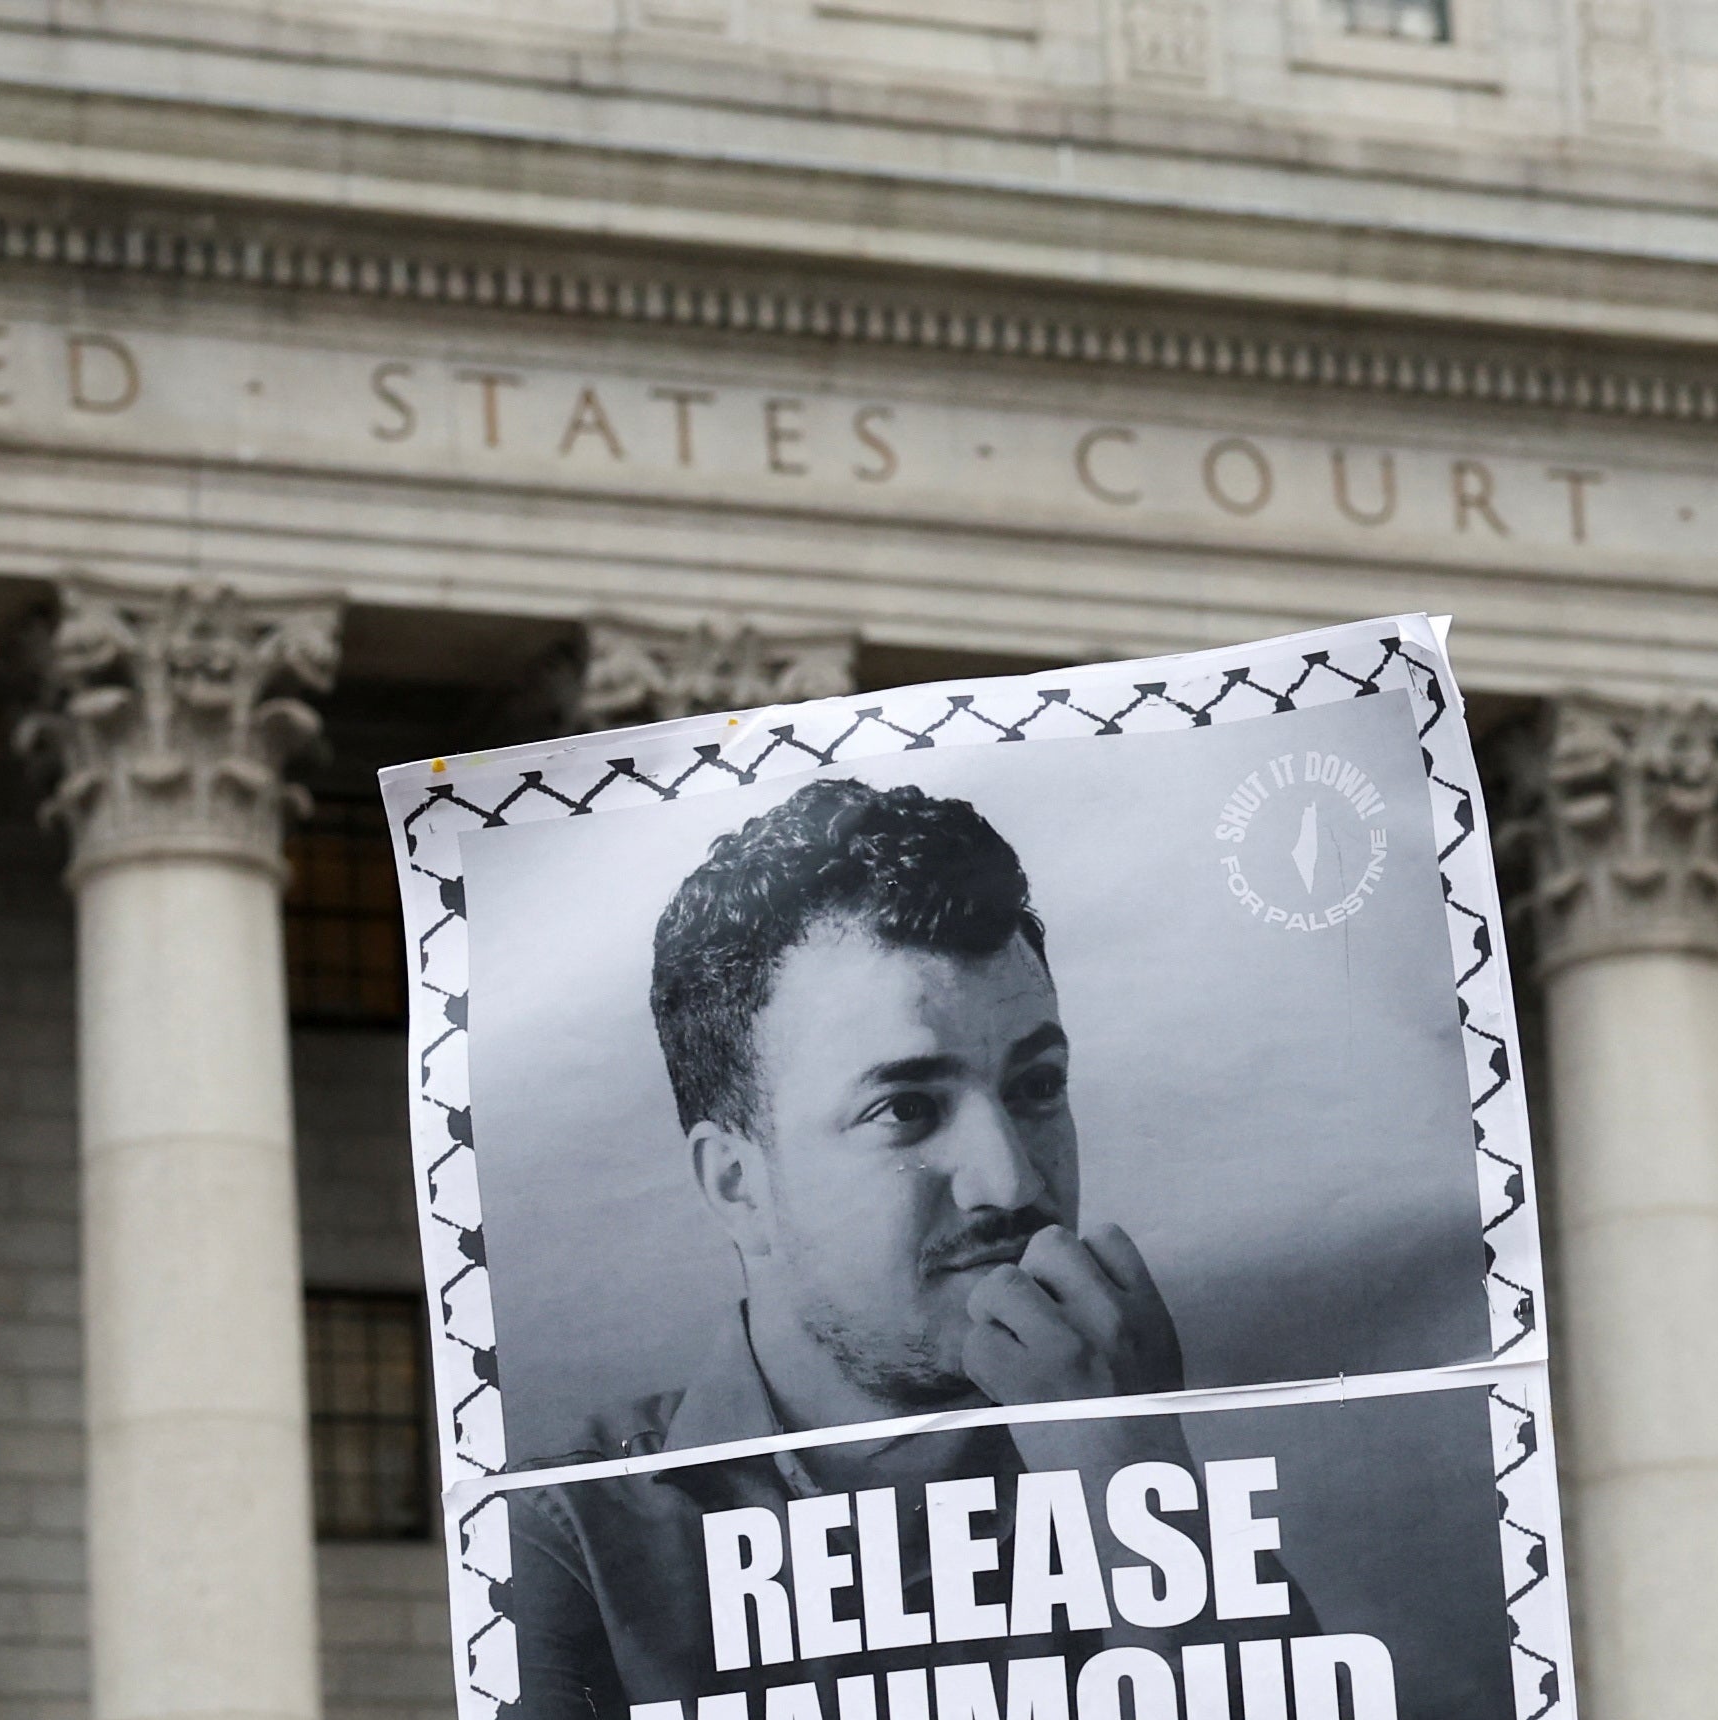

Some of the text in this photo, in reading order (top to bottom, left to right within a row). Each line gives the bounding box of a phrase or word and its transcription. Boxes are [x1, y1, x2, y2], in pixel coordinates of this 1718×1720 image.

[369, 360, 899, 484] STATES
[1076, 426, 1606, 545] COURT
[1215, 751, 1385, 843] SHUT IT DOWN!
[1220, 828, 1388, 932] FOR PALESTINE
[702, 1455, 1291, 1672] RELEASE
